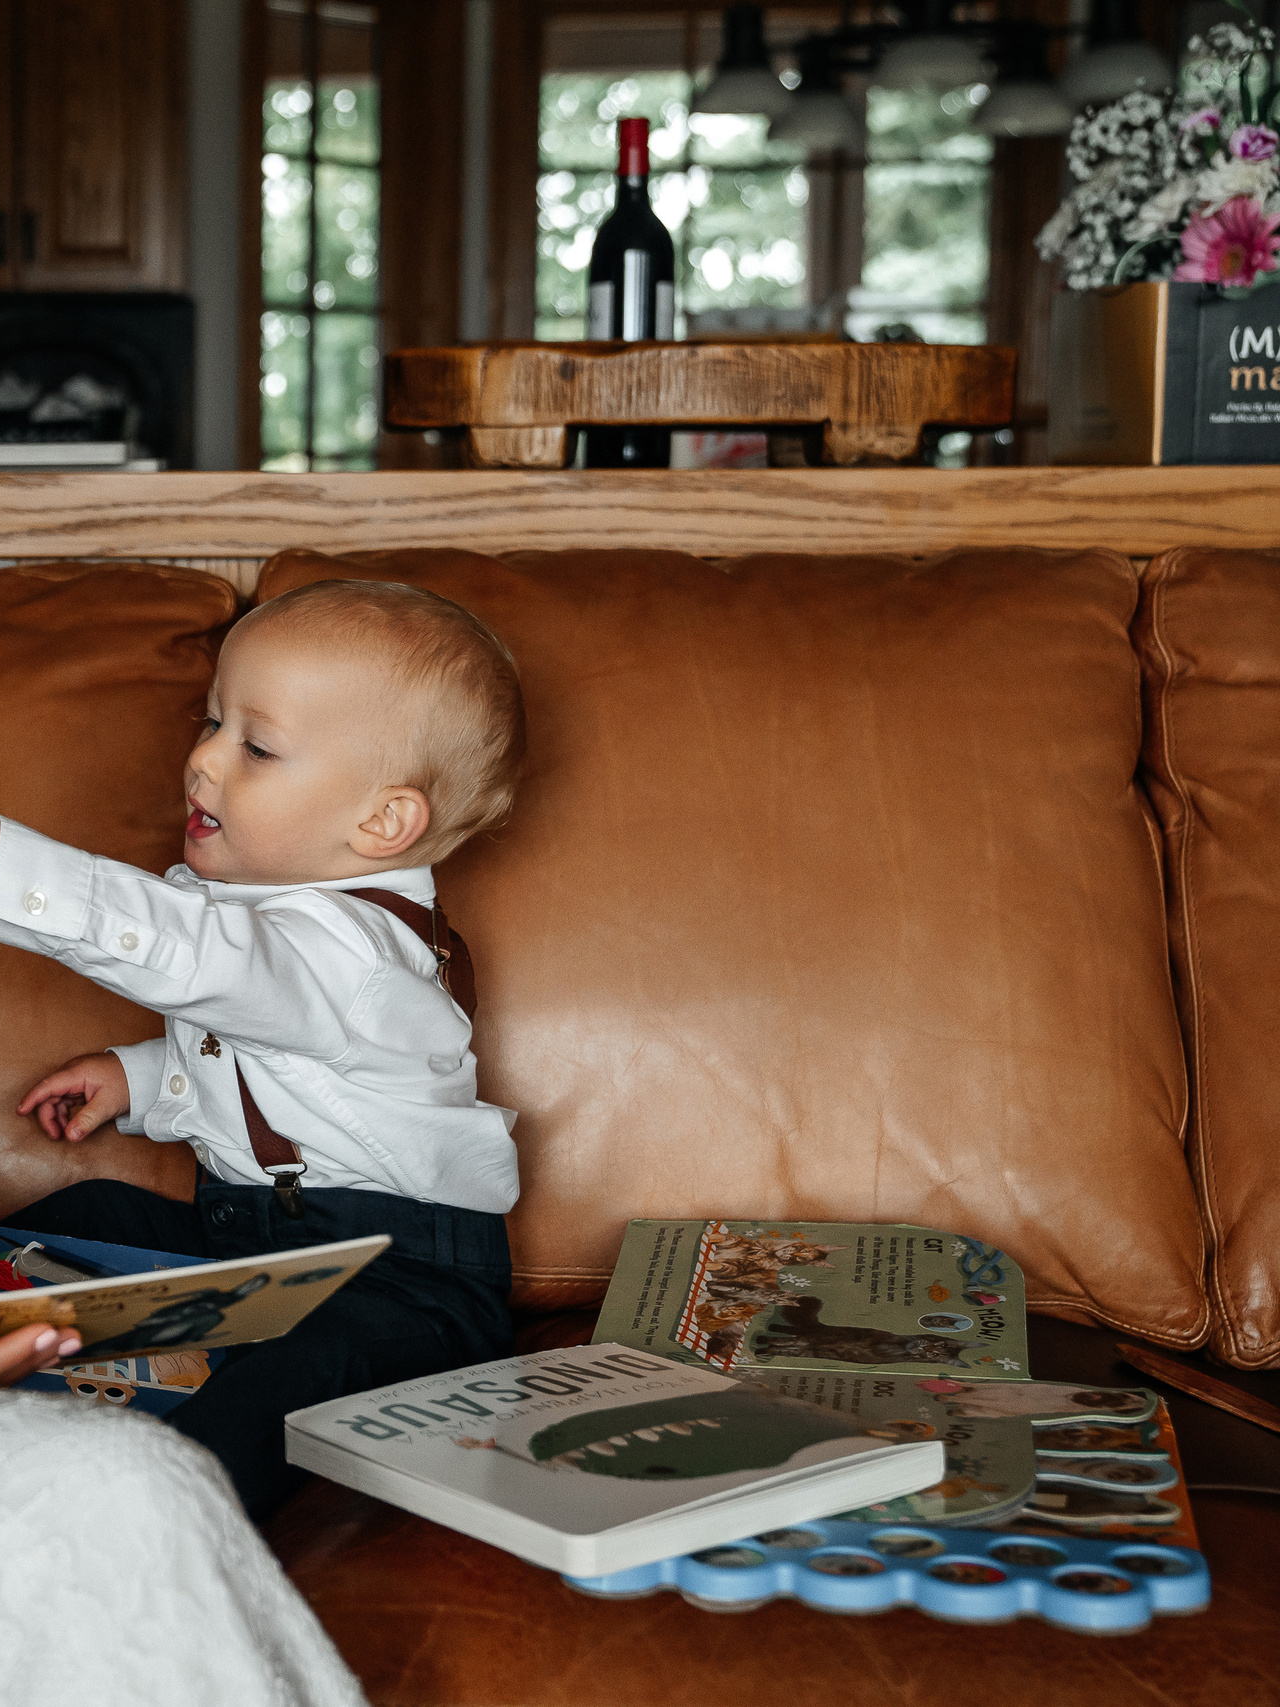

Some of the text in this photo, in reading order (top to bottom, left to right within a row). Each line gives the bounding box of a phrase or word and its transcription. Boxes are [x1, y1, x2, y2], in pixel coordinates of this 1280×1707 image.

[674, 1227, 685, 1235] The
[671, 1235, 683, 1245] Maine
[857, 1236, 867, 1247] claws
[890, 1237, 900, 1246] lions
[906, 1238, 916, 1249] House
[669, 1246, 677, 1255] coon
[889, 1246, 899, 1254] and
[924, 1238, 944, 1254] CAT
[649, 1250, 663, 1260] bushy
[873, 1248, 881, 1258] same
[906, 1249, 915, 1257] cats
[855, 1265, 866, 1274] their
[885, 1266, 899, 1276] They
[905, 1265, 915, 1278] related
[644, 1277, 653, 1287] come
[658, 1277, 672, 1289] largest
[887, 1276, 896, 1286] even
[868, 1279, 881, 1294] sharpen
[637, 1291, 649, 1300] many
[656, 1290, 669, 1301] breeds
[870, 1295, 881, 1304] their
[887, 1292, 895, 1303] some
[904, 1291, 914, 1299] cats
[904, 1299, 915, 1307] like
[635, 1302, 649, 1317] different
[652, 1307, 663, 1317] house
[973, 1308, 1006, 1341] MEOW!
[644, 1325, 659, 1335] They
[644, 1336, 656, 1346] have
[520, 1354, 567, 1370] Linda
[466, 1362, 520, 1377] Bailey
[402, 1379, 448, 1394] Colin
[813, 1384, 825, 1394] many
[873, 1380, 895, 1398] DOG
[335, 1353, 676, 1442] DINOSAUR
[364, 1389, 400, 1406] Jack
[529, 1388, 626, 1412] HAPPEN
